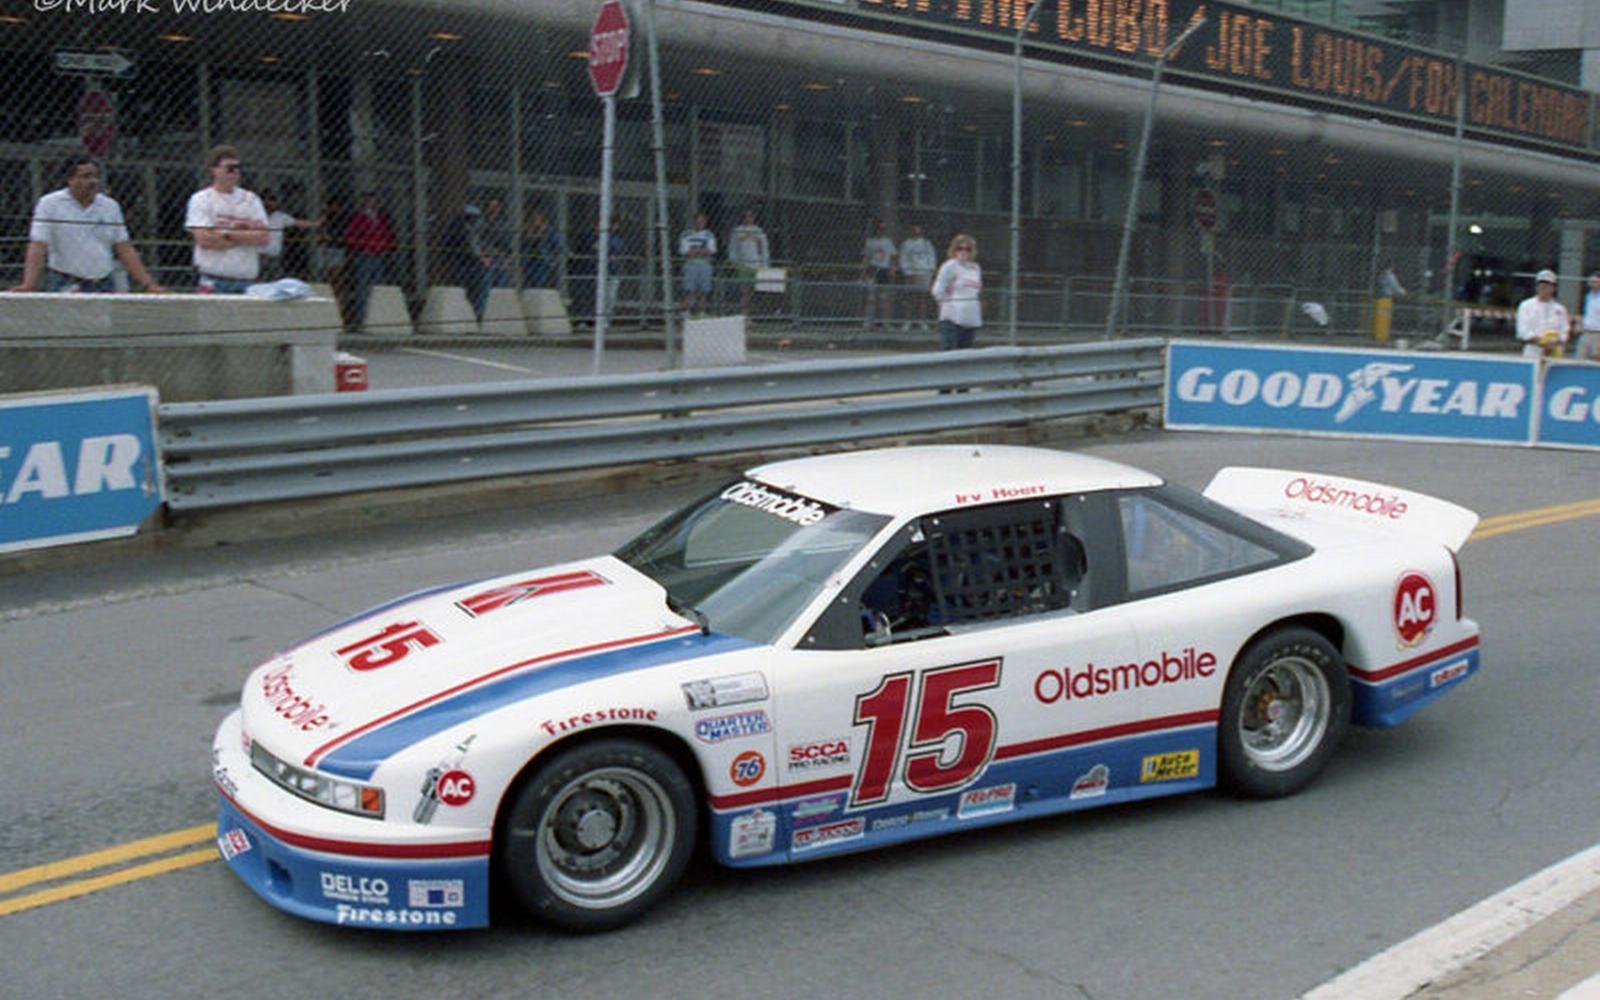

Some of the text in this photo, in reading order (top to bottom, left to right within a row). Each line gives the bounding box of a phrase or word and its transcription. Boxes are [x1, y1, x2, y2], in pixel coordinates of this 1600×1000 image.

[0, 433, 141, 503] AR
[721, 481, 826, 526] Oldsmobile
[1285, 477, 1409, 520] Oldsmobile
[1398, 586, 1432, 629] AC
[333, 619, 442, 673] 15
[1034, 647, 1217, 705] Oldsmobile
[262, 663, 330, 732] Oldsmobile
[540, 707, 659, 737] Firestone
[696, 713, 765, 736] QUARTER
[709, 721, 768, 740] MASTER
[850, 656, 1003, 812] 15
[735, 757, 761, 781] 76
[790, 741, 849, 761] SCCA
[441, 778, 472, 799] AC
[320, 872, 389, 896] DELCO
[336, 903, 457, 925] Firestone
